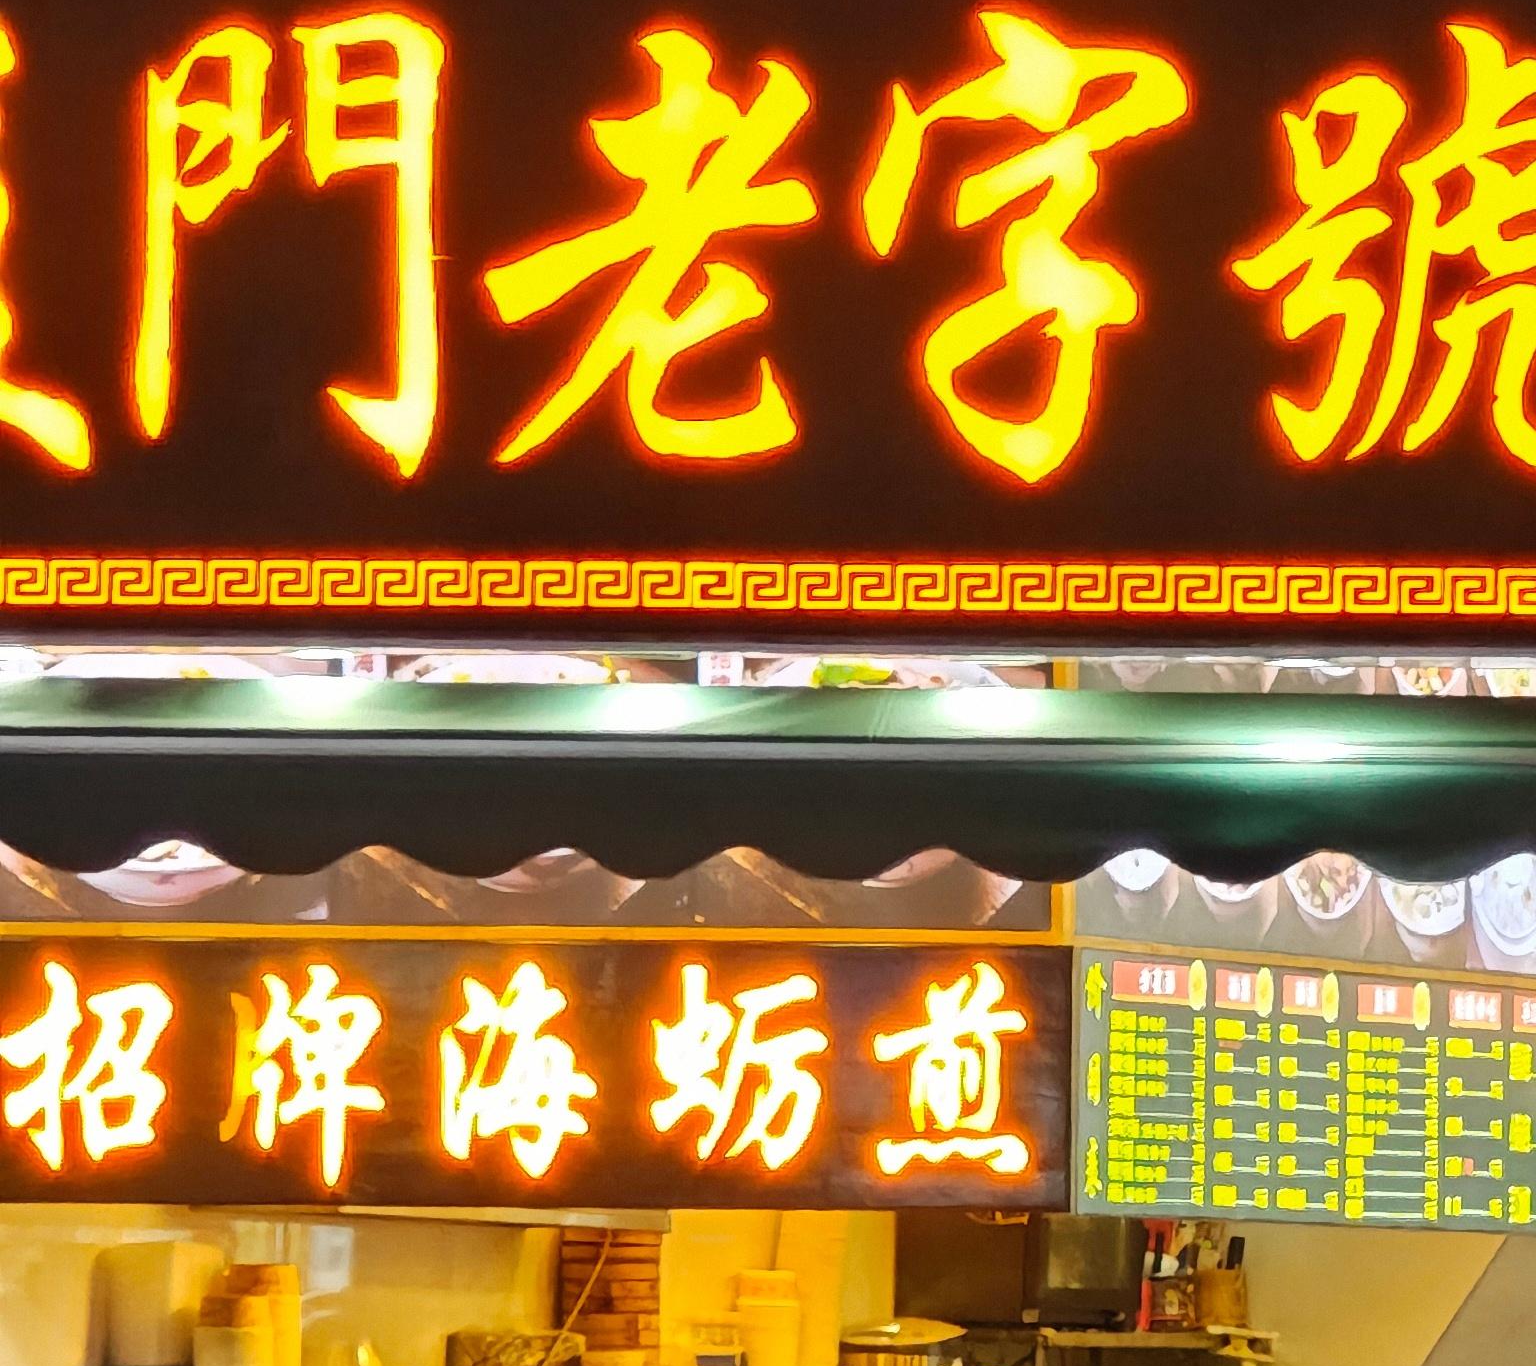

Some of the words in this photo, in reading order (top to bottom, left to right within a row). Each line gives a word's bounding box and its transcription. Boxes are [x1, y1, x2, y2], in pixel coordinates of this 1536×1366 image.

[0, 959, 1030, 1188] 招牌海蛎煎
